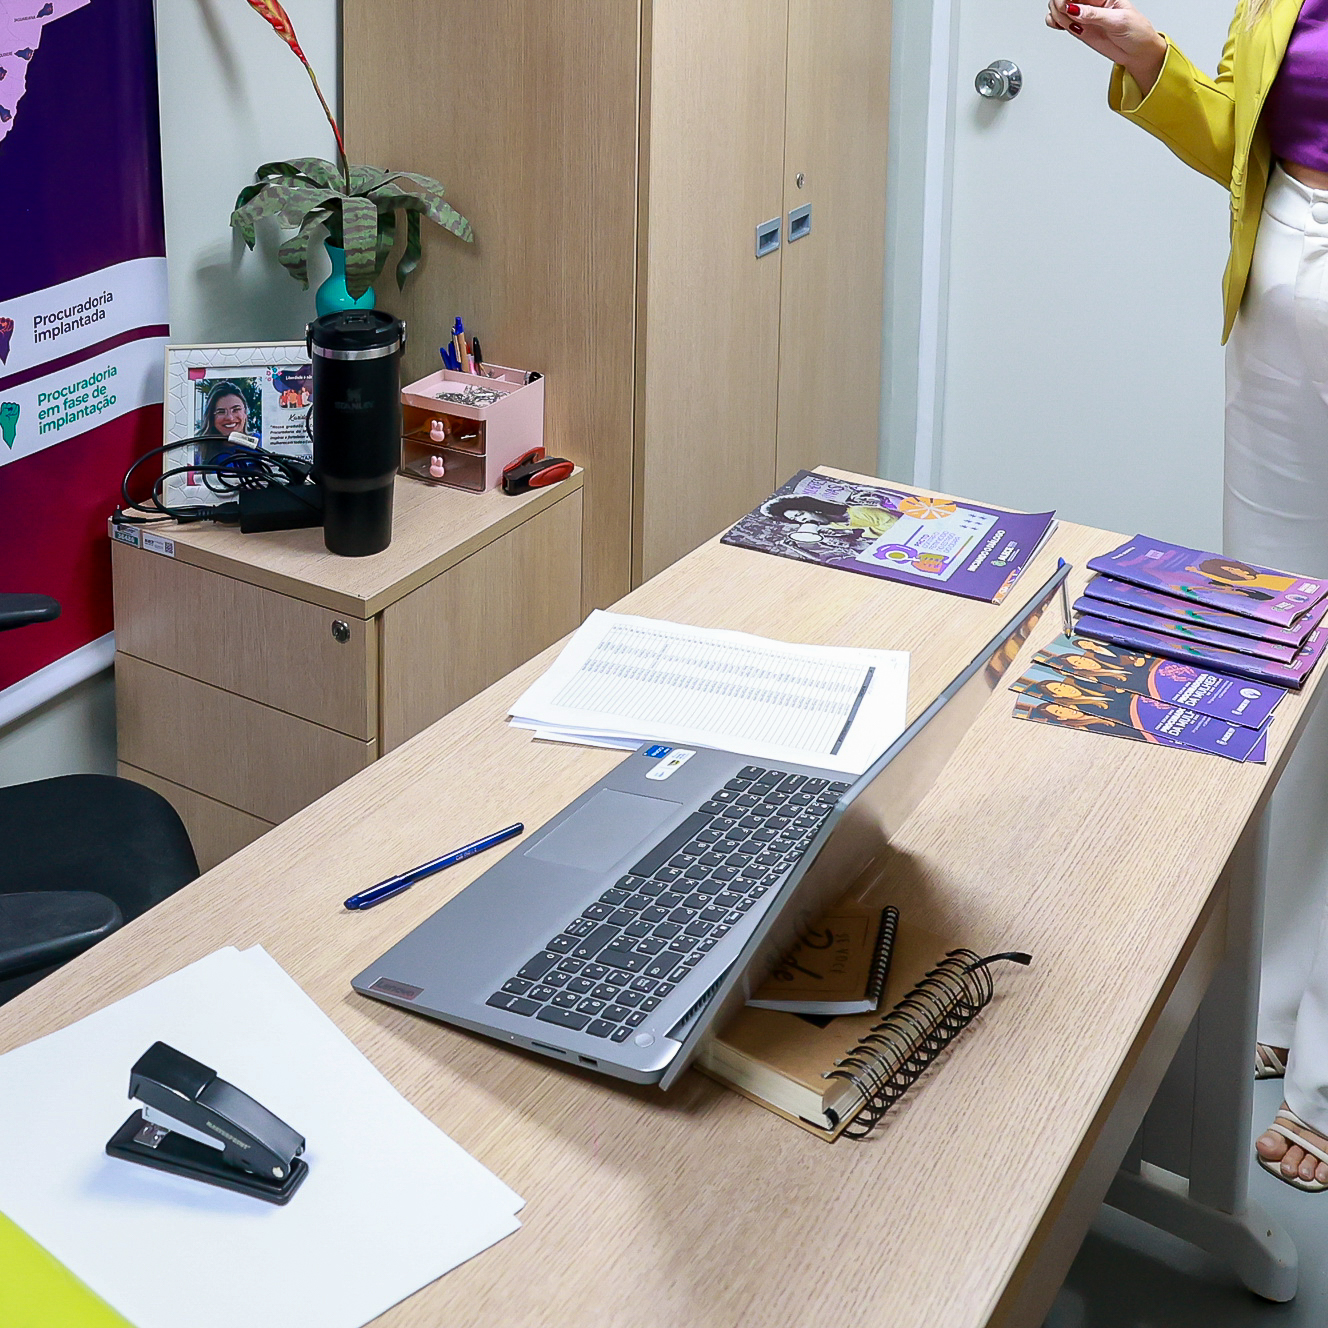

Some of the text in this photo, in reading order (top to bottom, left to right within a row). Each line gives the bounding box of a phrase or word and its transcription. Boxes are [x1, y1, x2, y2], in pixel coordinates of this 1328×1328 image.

[33, 291, 114, 328] Procuradoria
[34, 308, 106, 343] implantada
[37, 365, 117, 406] Procuradoria
[38, 385, 107, 420] em fase de
[39, 393, 117, 435] implantação
[1185, 696, 1197, 706] DA
[377, 981, 414, 996] Lenovo
